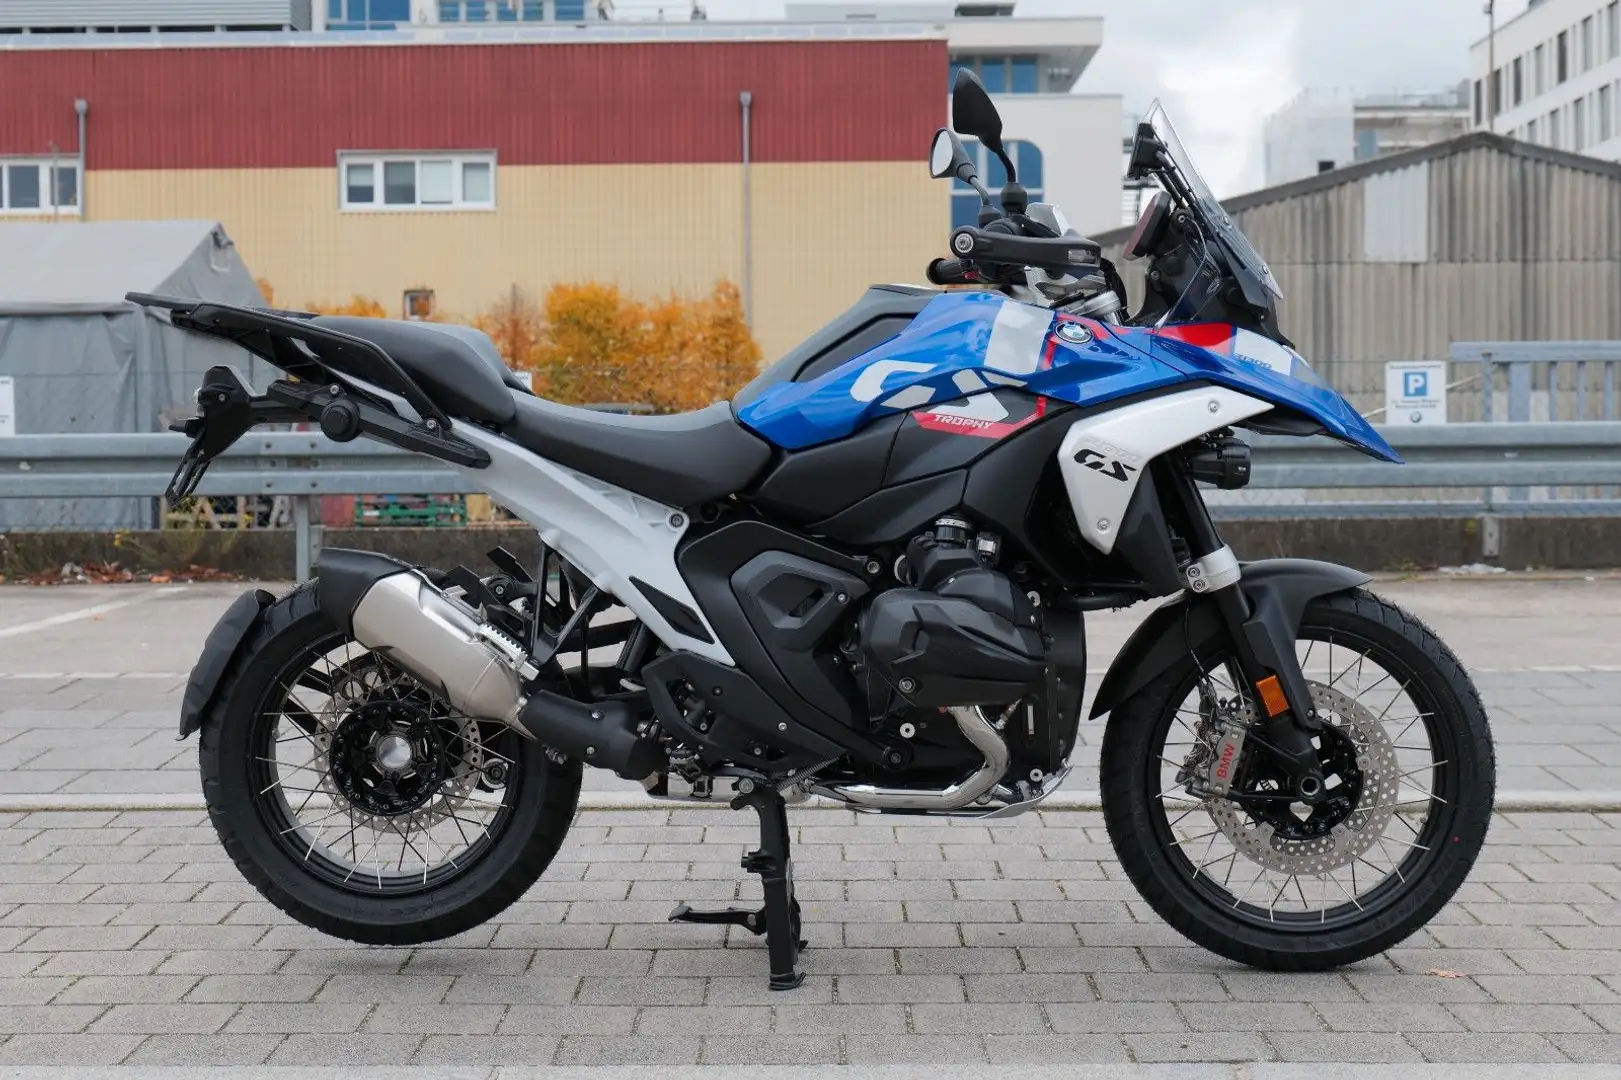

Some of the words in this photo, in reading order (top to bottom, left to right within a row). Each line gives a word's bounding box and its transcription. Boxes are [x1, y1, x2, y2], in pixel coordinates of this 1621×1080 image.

[1408, 374, 1425, 394] P
[935, 414, 993, 429] TROPHY
[1073, 448, 1137, 482] GS
[1216, 743, 1235, 778] BMW
